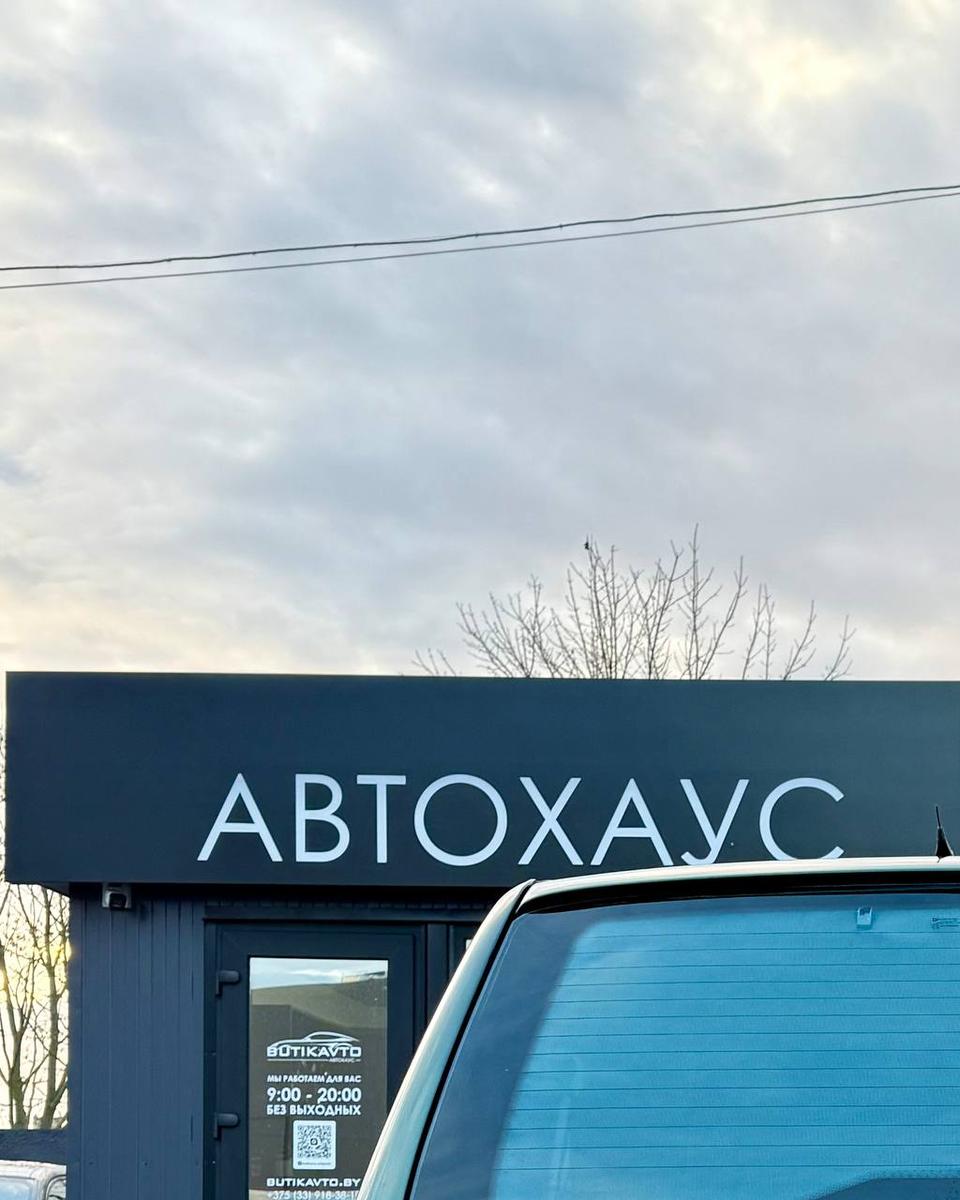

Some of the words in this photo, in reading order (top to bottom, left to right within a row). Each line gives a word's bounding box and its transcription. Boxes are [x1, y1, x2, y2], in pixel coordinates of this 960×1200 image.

[197, 773, 845, 867] АВТОХАУС
[266, 1046, 362, 1058] BUTIKAVTO
[266, 1075, 282, 1083] МЫ
[283, 1075, 325, 1083] РАБОТАЕМ
[326, 1075, 343, 1083] ДЛЯ
[344, 1075, 362, 1083] ВАС
[266, 1087, 302, 1103] 9:00
[317, 1087, 362, 1103] 20:00
[266, 1105, 287, 1115] БЕЗ
[289, 1105, 361, 1116] ВЫХОДНЫХ
[266, 1178, 361, 1187] BUTIKAVTO.BY
[293, 1190, 311, 1200] (33)
